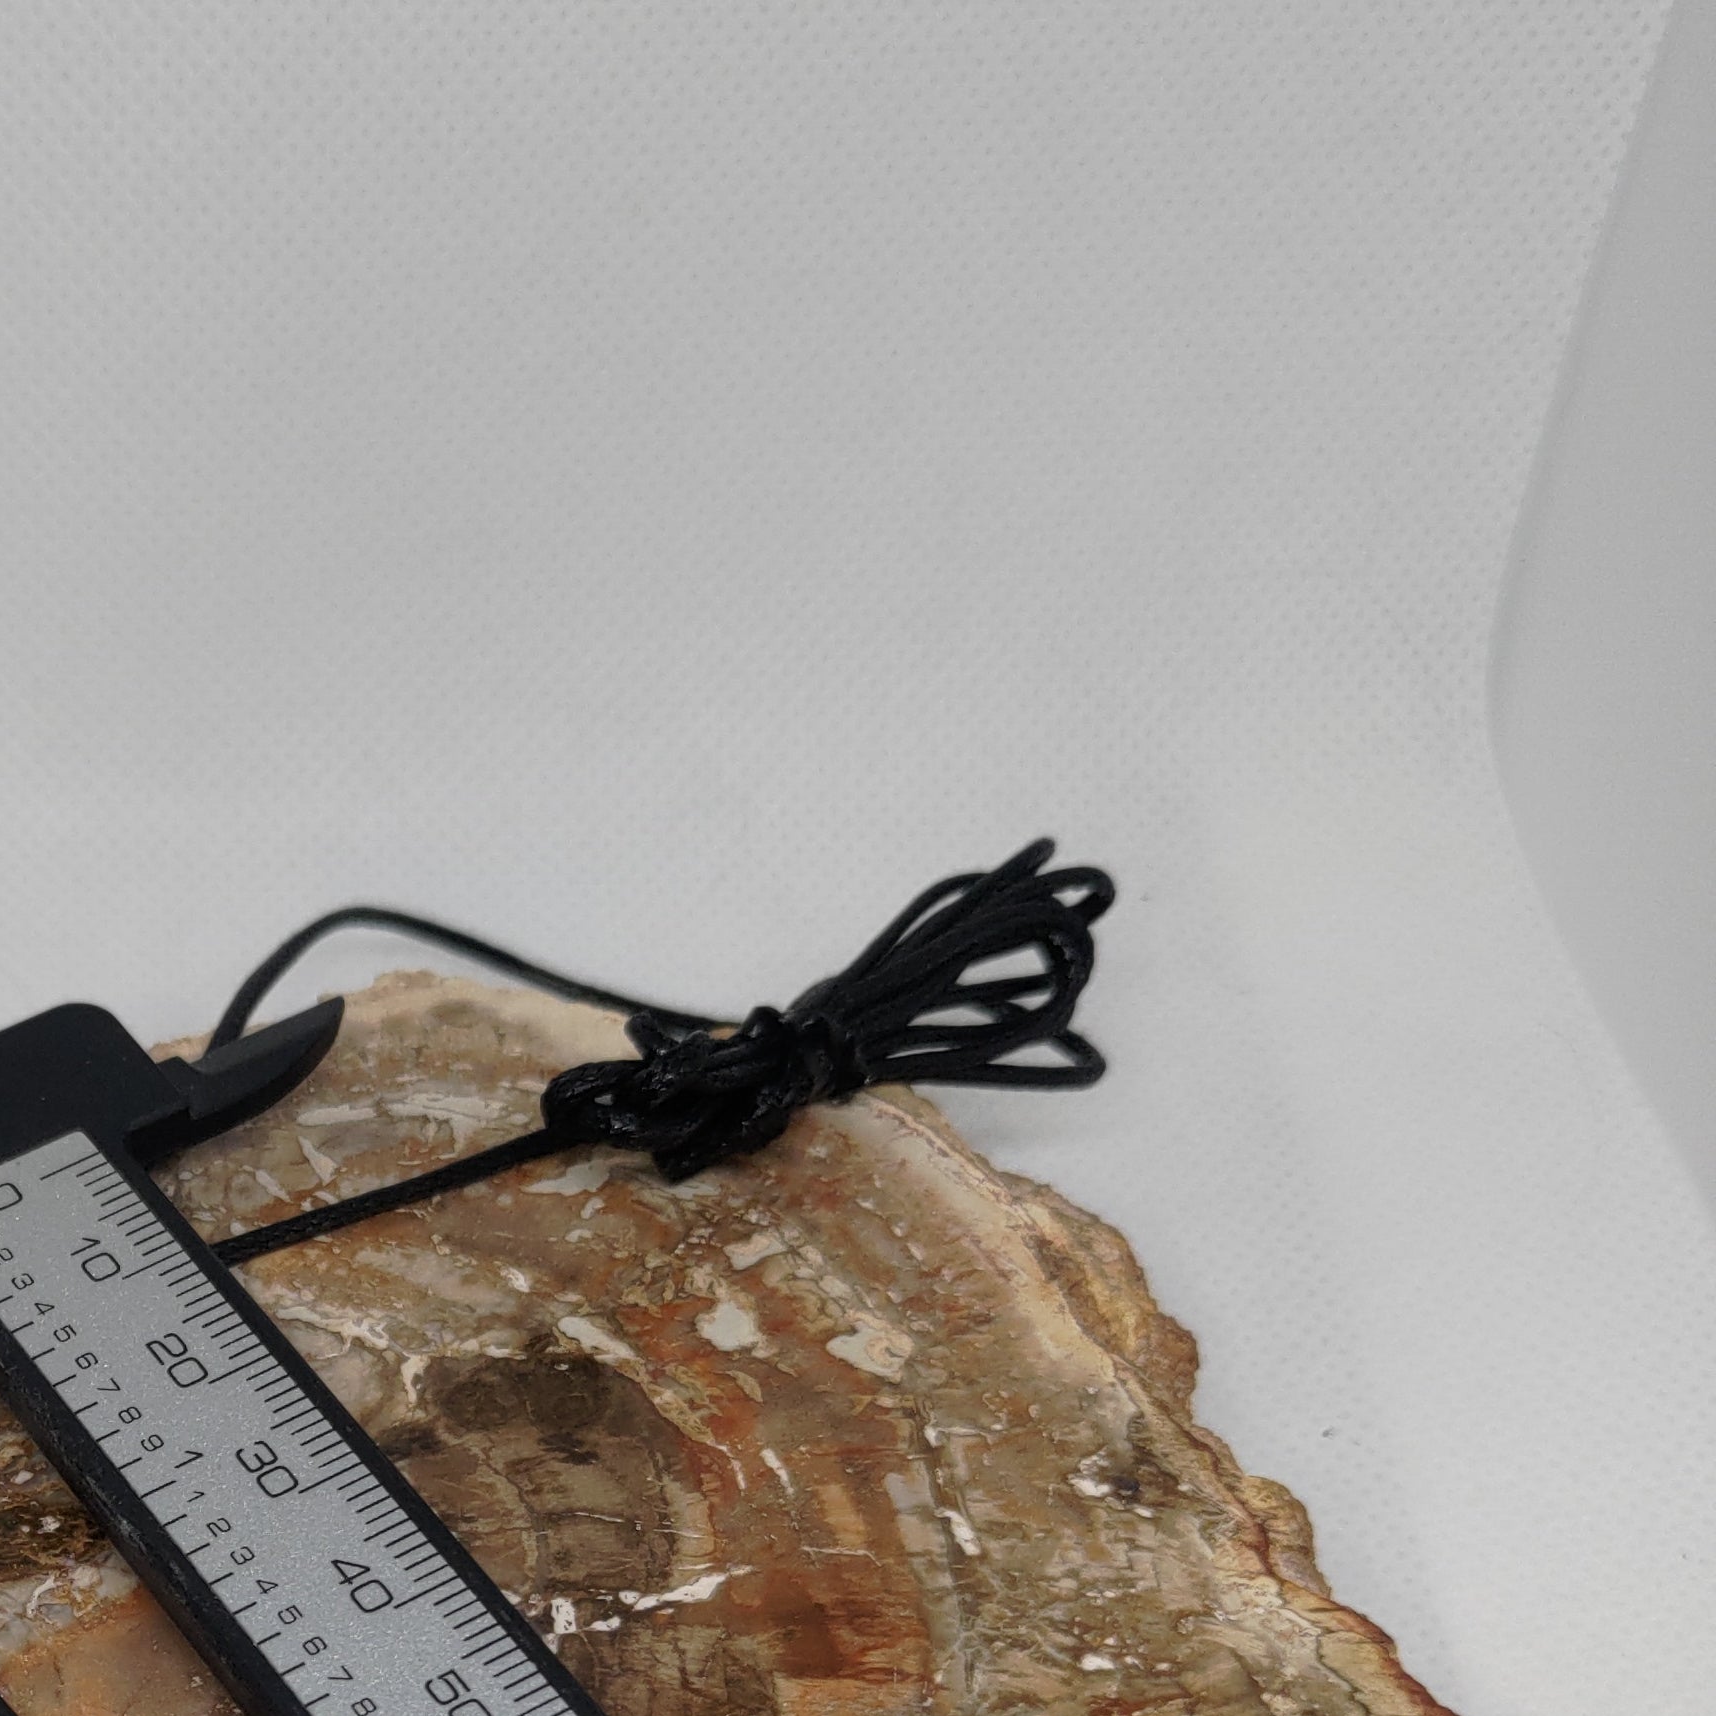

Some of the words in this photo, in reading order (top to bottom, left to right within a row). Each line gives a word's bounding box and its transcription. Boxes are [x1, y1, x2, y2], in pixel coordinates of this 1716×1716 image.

[10, 1272, 36, 1291] 3
[33, 1301, 57, 1317] 4
[52, 1324, 78, 1344] 5
[74, 1352, 100, 1371] 6
[96, 1378, 122, 1394] 7
[118, 1406, 143, 1425] 8
[69, 1237, 122, 1283] 10
[143, 1332, 210, 1389] 20
[235, 1440, 300, 1498] 30
[330, 1558, 395, 1614] 40
[140, 1434, 166, 1453] 9
[174, 1450, 205, 1469] 1
[187, 1491, 206, 1502] 1
[206, 1517, 233, 1538] 2
[229, 1546, 257, 1566] 3
[255, 1579, 280, 1595] 4
[277, 1605, 304, 1625] 5
[302, 1637, 329, 1656] 6
[327, 1666, 354, 1683] 7
